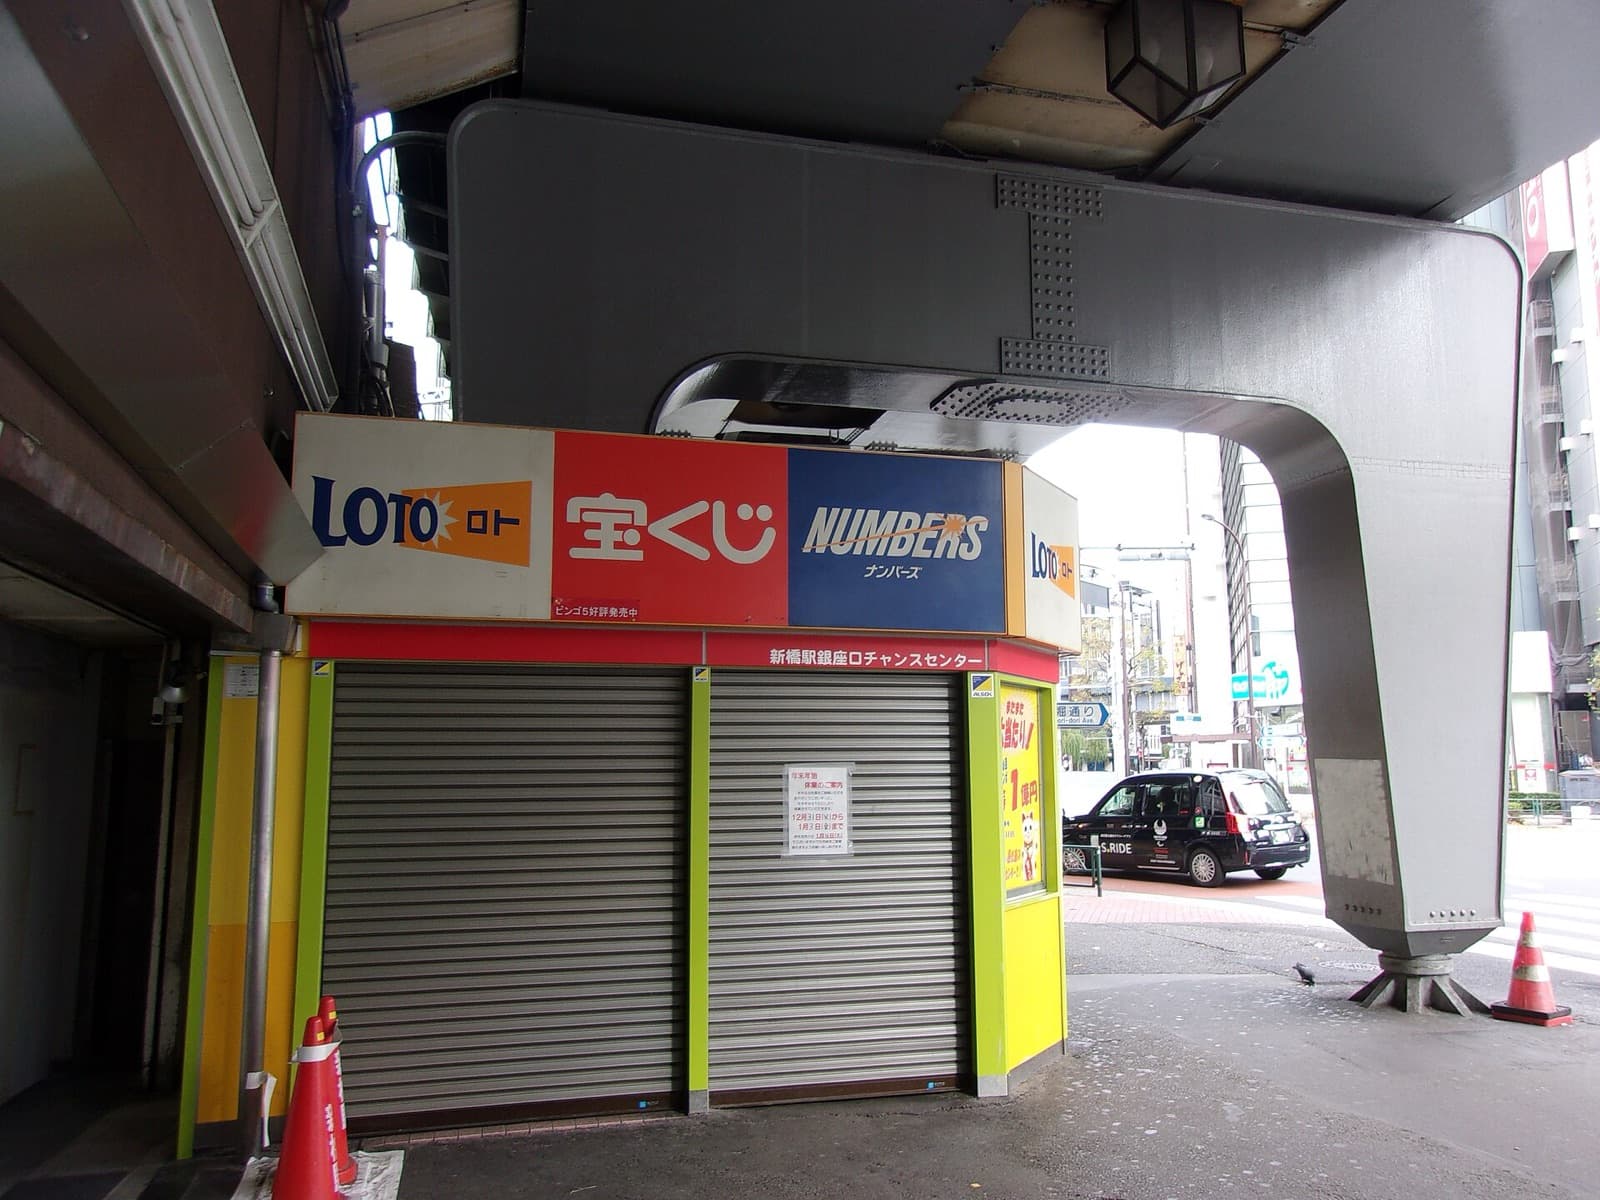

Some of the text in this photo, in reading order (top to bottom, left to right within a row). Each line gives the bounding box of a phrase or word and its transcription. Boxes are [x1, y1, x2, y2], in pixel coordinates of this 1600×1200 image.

[311, 475, 520, 547] LOTO ロト
[566, 492, 777, 565] 宝くじ
[801, 506, 989, 561] NUMBERS
[863, 563, 923, 580] ナンバーズ
[1031, 532, 1058, 580] LOTO
[769, 648, 983, 668] 新橋駅銀座口チャンスセンター
[1101, 842, 1132, 854] S.RIDE
